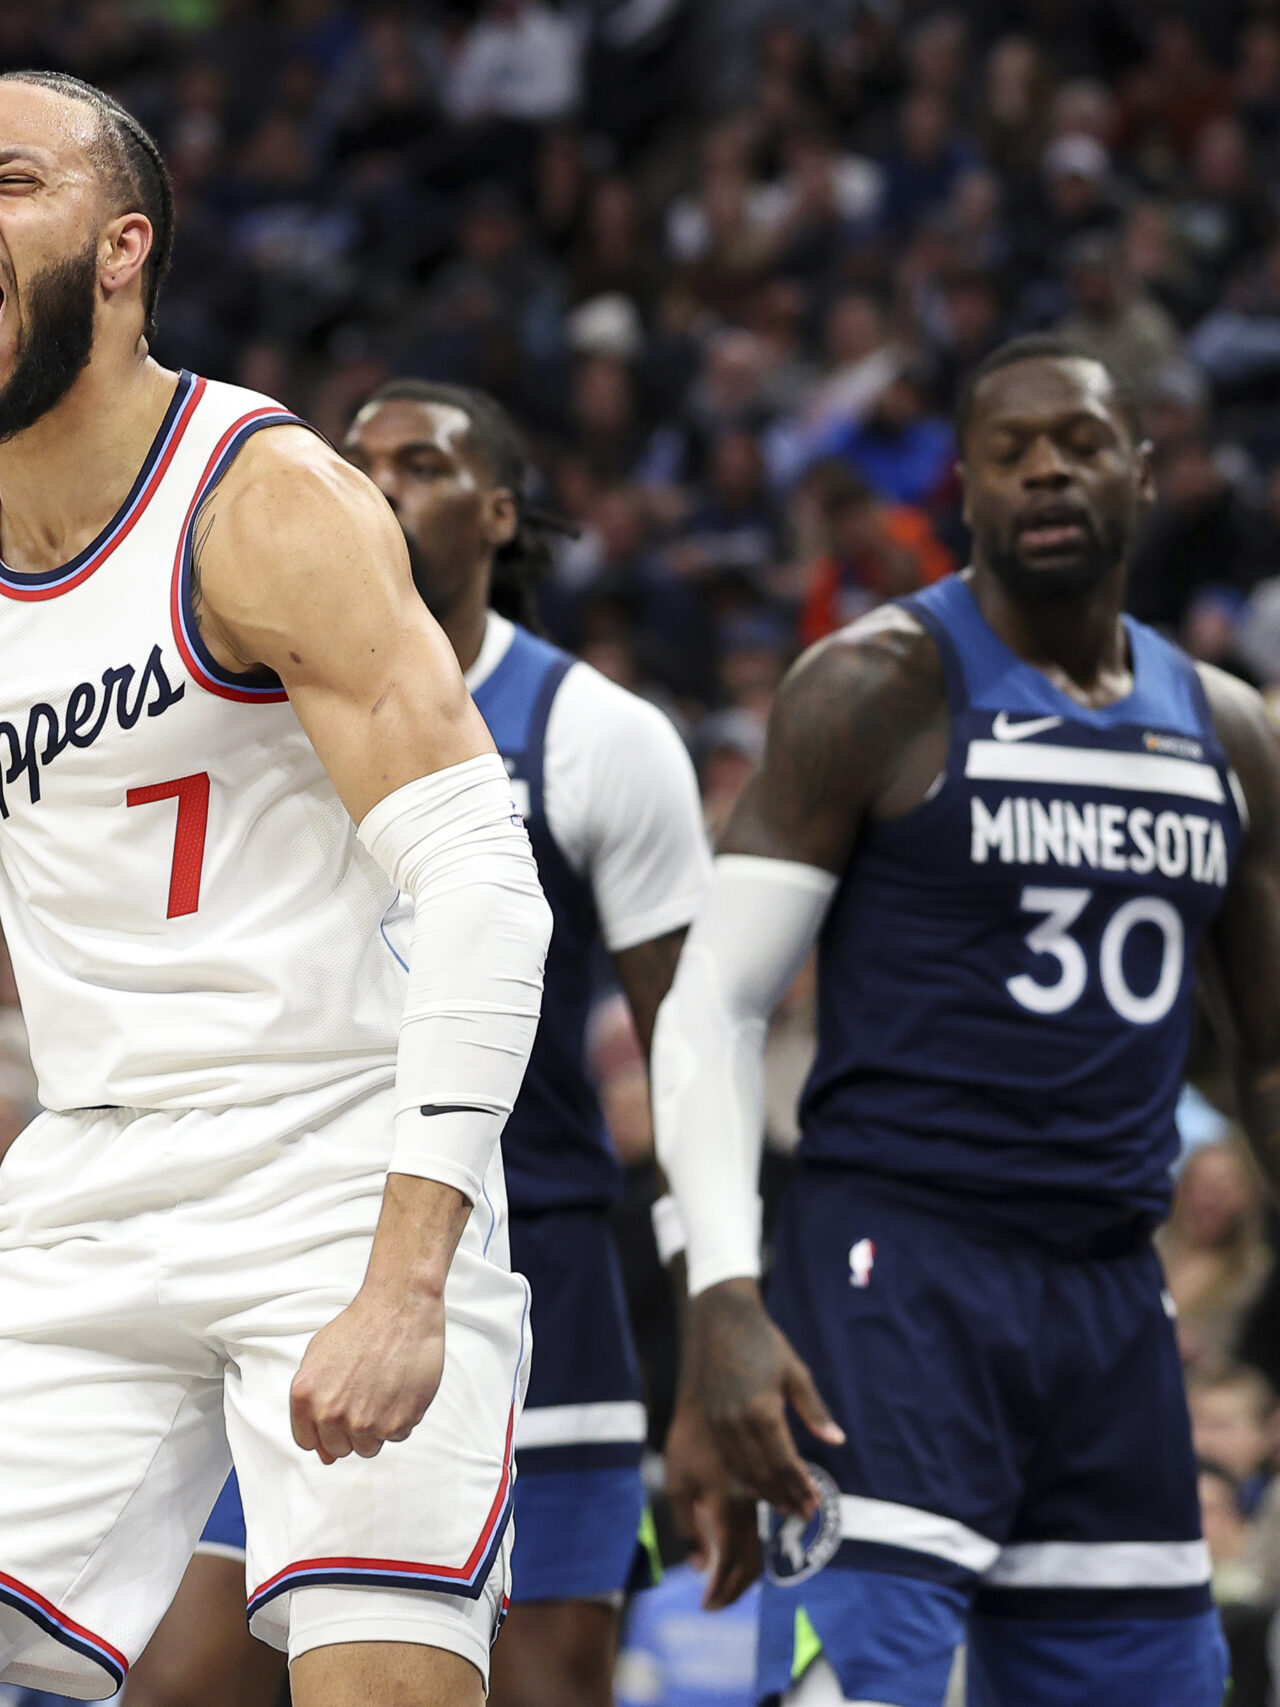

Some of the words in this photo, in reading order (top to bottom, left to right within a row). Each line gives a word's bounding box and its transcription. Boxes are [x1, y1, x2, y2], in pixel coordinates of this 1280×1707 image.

[126, 771, 210, 919] 7
[970, 796, 1228, 887] MINNESOTA
[1006, 885, 1184, 1024] 30
